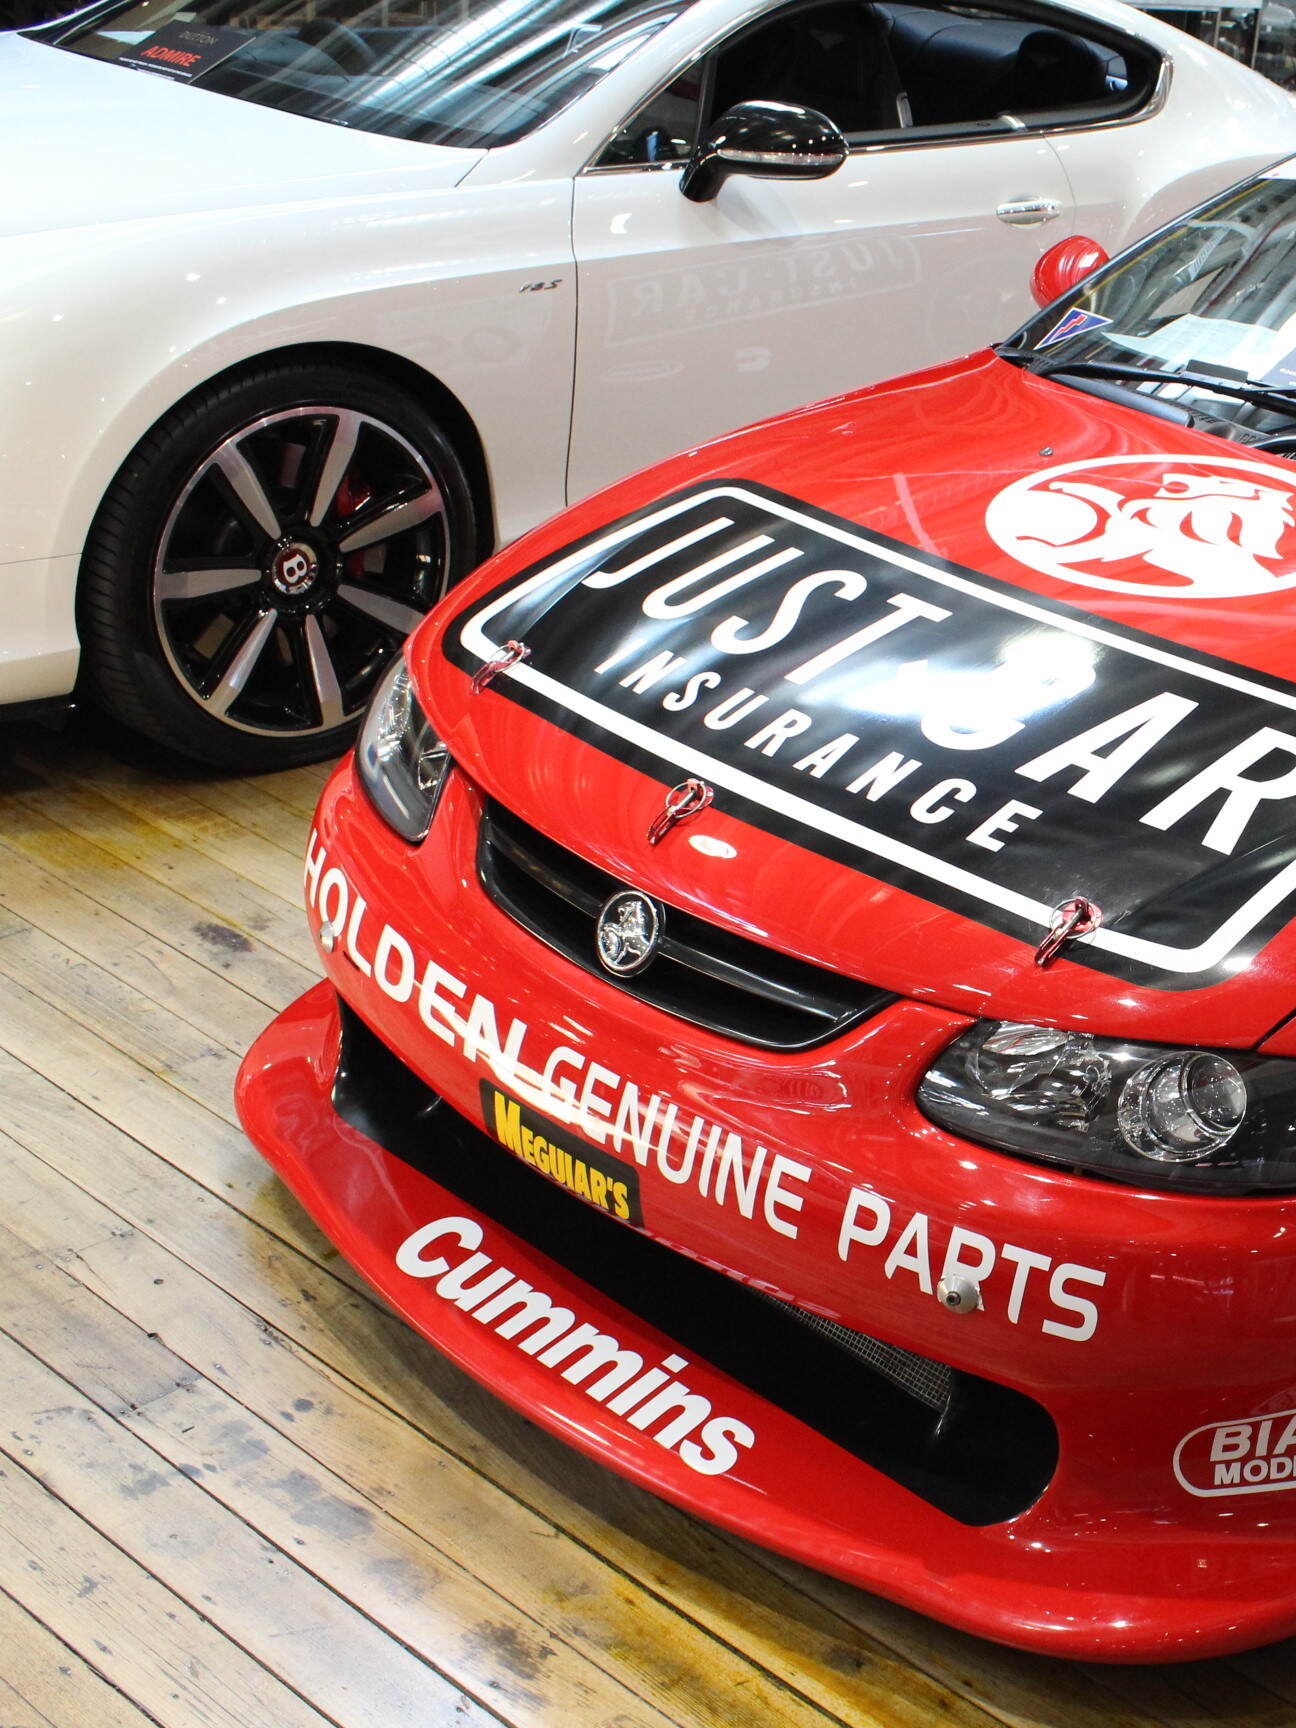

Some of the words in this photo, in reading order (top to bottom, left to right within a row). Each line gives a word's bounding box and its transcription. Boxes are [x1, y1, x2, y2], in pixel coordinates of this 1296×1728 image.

[140, 46, 202, 67] ADMIRE
[581, 516, 953, 685] JUST
[595, 639, 1043, 853] INSURANCE
[303, 829, 528, 1076] HOLDEN
[542, 1045, 812, 1240] GENUINE
[837, 1186, 1107, 1342] PARTS
[395, 1216, 756, 1476] Cummins
